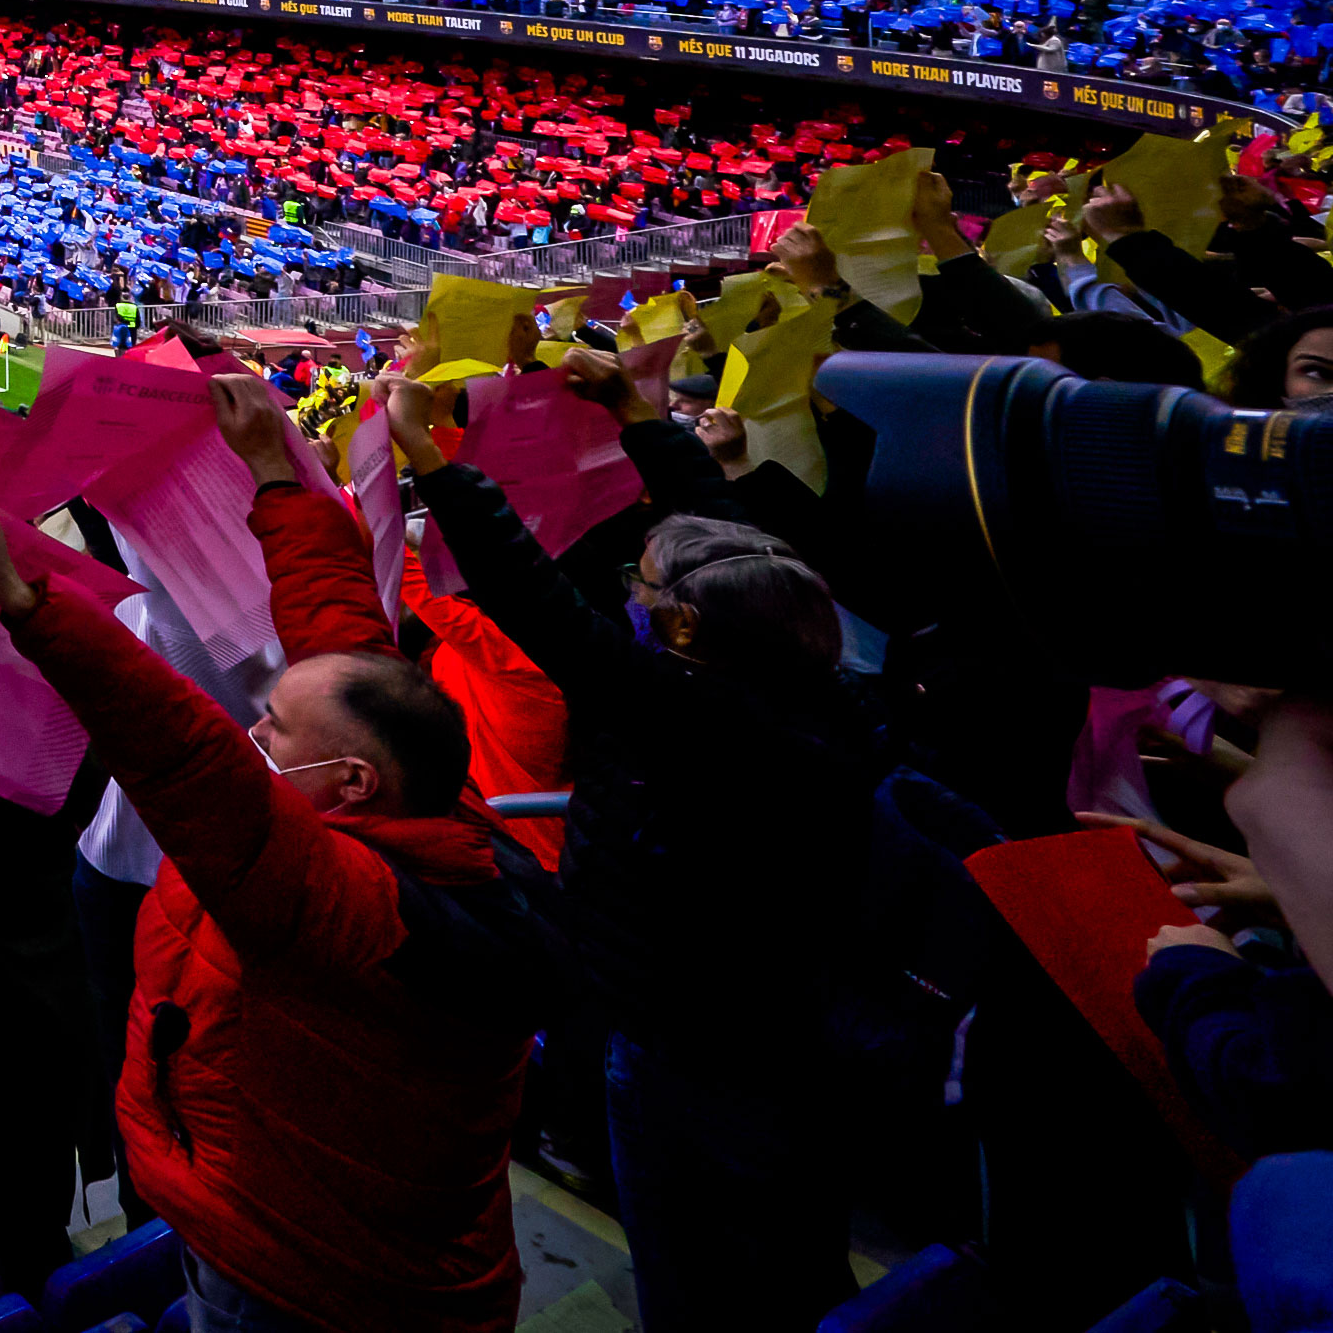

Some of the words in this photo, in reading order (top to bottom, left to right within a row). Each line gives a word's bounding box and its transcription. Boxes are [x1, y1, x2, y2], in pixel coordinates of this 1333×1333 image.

[280, 0, 298, 13] MÉS
[299, 3, 318, 15] QUE
[319, 4, 352, 18] TALENT
[387, 11, 414, 24] MORE
[416, 13, 443, 27] THAN
[445, 16, 482, 31] TALENT
[526, 23, 549, 38] MÉS
[550, 27, 575, 41] QUE
[576, 29, 594, 43] UN
[596, 31, 625, 46] CLUB
[679, 38, 704, 55] MÉS
[706, 43, 733, 58] QUE
[734, 45, 746, 59] 11
[748, 46, 820, 68] JUGADORS
[871, 59, 910, 78] MORE
[913, 63, 949, 83] THAN
[952, 69, 963, 85] 11
[966, 71, 1022, 94] PLAYERS
[1073, 84, 1098, 105] MÉS
[1100, 90, 1126, 112] QUE
[1127, 95, 1145, 114] UN
[1146, 98, 1176, 120] CLUB
[117, 382, 137, 396] FC
